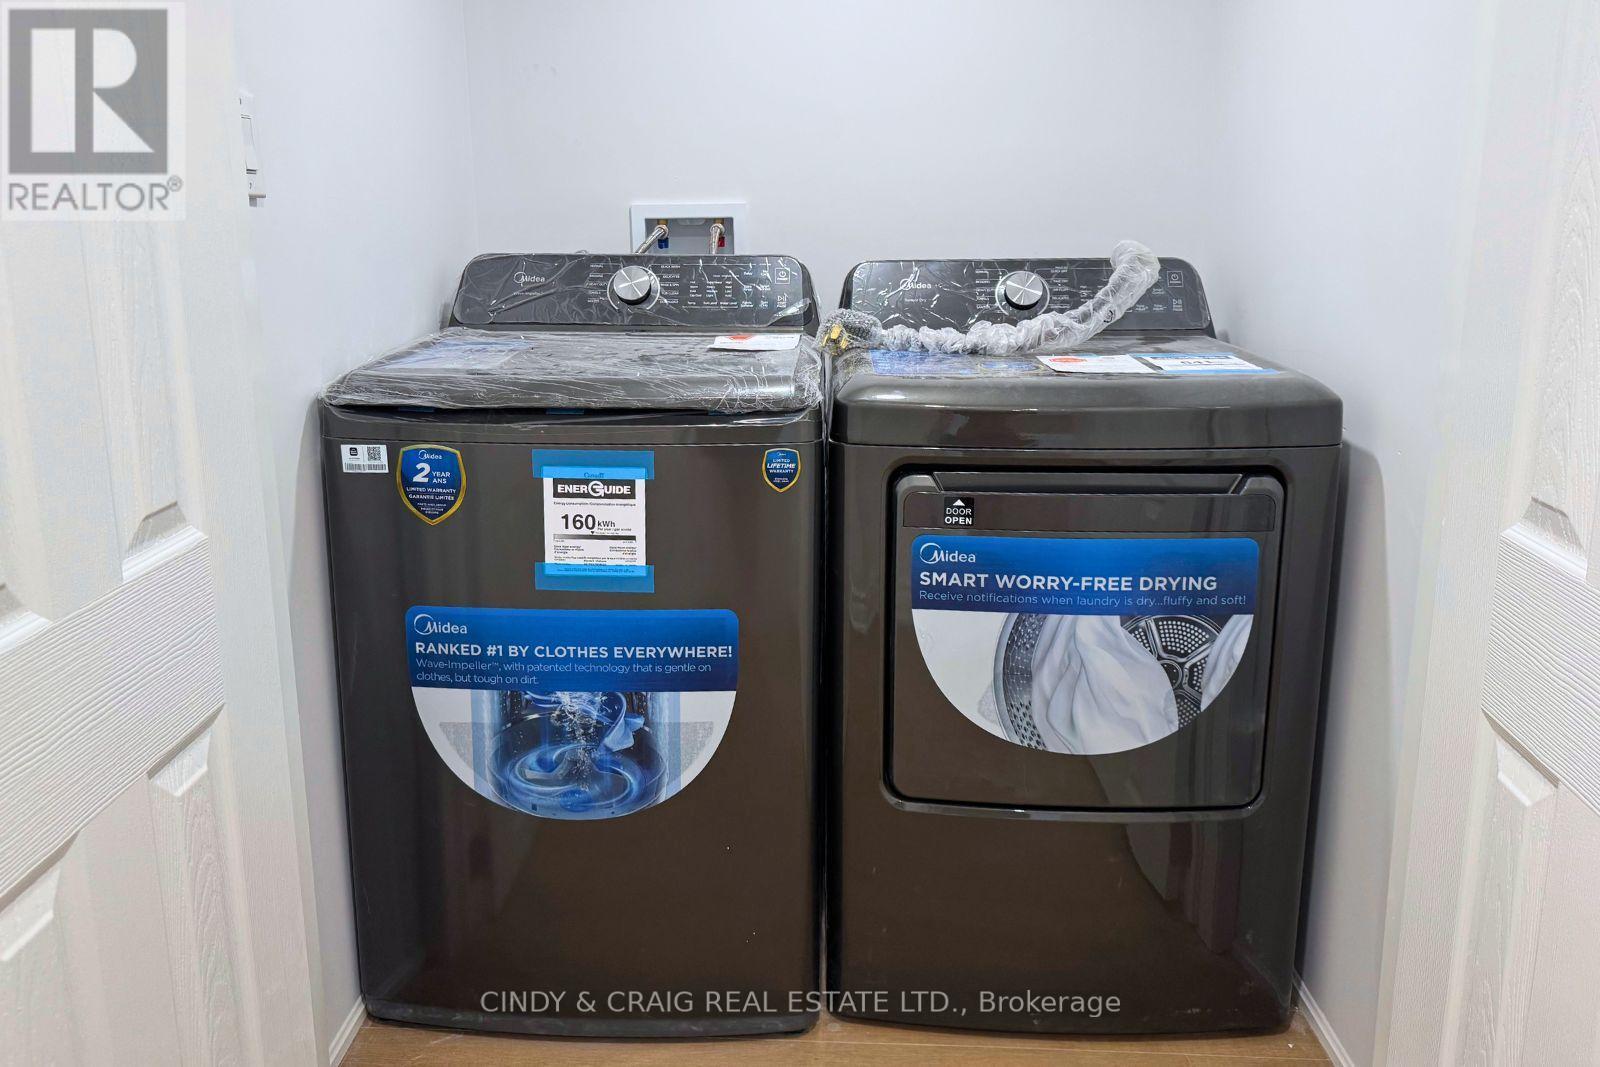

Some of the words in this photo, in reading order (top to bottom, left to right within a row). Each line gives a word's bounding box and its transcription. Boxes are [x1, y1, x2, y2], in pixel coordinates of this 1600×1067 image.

[513, 271, 546, 283] Midea
[899, 278, 932, 291] Midea
[418, 449, 442, 460] Midea
[412, 462, 431, 483] 2
[945, 507, 973, 516] DOOR
[561, 513, 596, 530] 160
[597, 520, 616, 528] kWh
[944, 516, 973, 525] OPEN
[919, 542, 977, 565] Midea
[919, 571, 989, 588] SMART
[995, 574, 1133, 591] WORRY-FREE
[1139, 576, 1218, 591] DRYING
[919, 590, 964, 601] Receive
[966, 592, 1038, 604] notifications
[1041, 595, 1073, 605] when
[1077, 596, 1120, 608] laundry
[1124, 596, 1133, 606] is
[1196, 596, 1218, 606] and
[1220, 595, 1246, 605] soft!
[413, 613, 468, 636] Midea
[415, 642, 482, 656] RANKED
[486, 644, 503, 657] #1
[508, 645, 530, 657] BY
[534, 646, 609, 659] CLOTHES
[613, 645, 733, 659] EVERYWHERE!
[503, 662, 525, 671] with
[527, 662, 572, 674] patented
[574, 663, 630, 674] technology
[632, 663, 652, 673] that
[654, 663, 663, 673] is
[664, 663, 696, 674] gentle
[697, 664, 712, 672] on
[416, 672, 454, 683] clothes,
[454, 673, 472, 683] but
[473, 674, 503, 685] tough
[504, 676, 519, 684] on
[520, 675, 540, 685] dirt.
